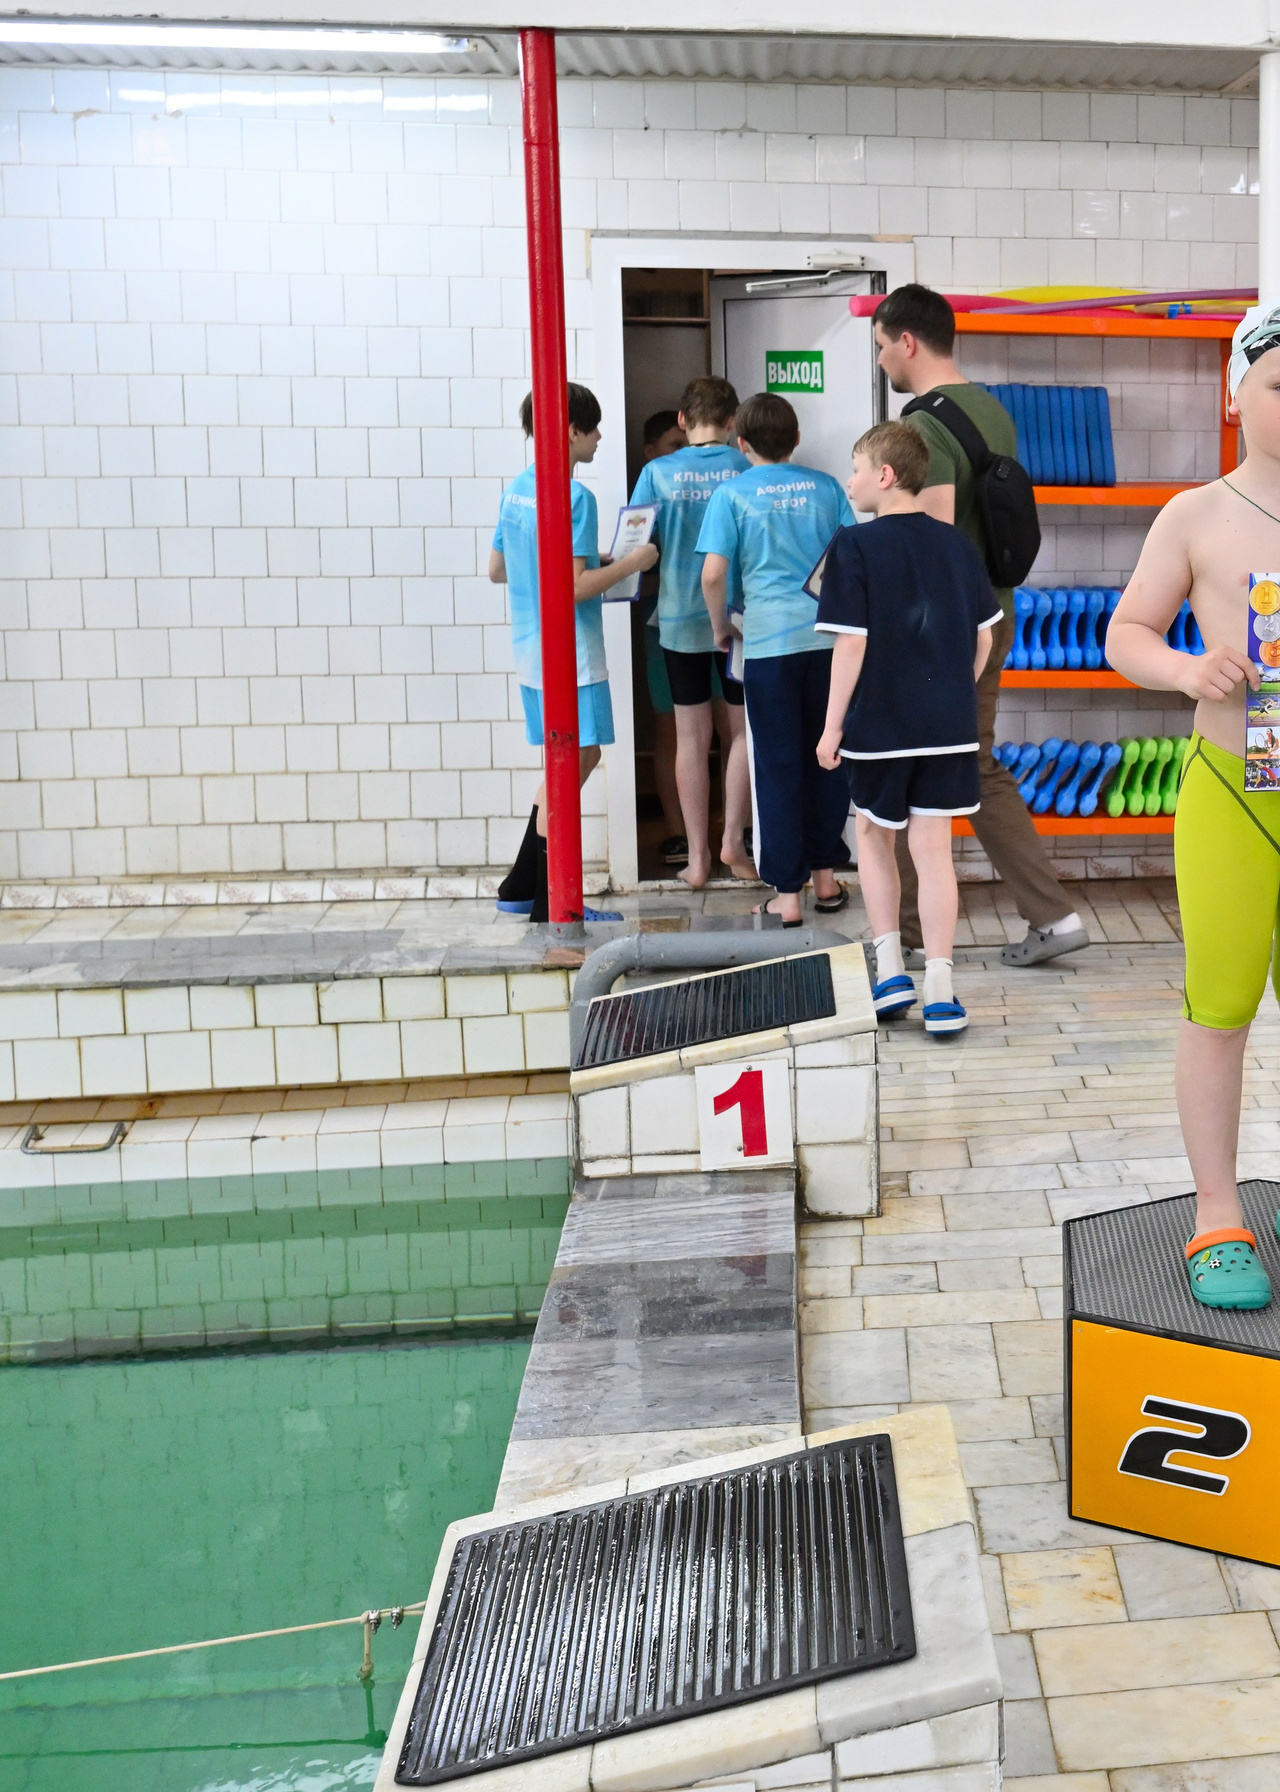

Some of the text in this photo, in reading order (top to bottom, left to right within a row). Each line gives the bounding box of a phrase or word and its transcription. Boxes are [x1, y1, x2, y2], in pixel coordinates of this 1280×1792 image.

[767, 361, 822, 388] ВЫХОД
[672, 489, 713, 501] ГЕОР
[756, 481, 816, 496] АФОНИН
[773, 497, 808, 510] ЕГОР
[713, 1070, 768, 1157] 1
[1117, 1394, 1251, 1496] 2
